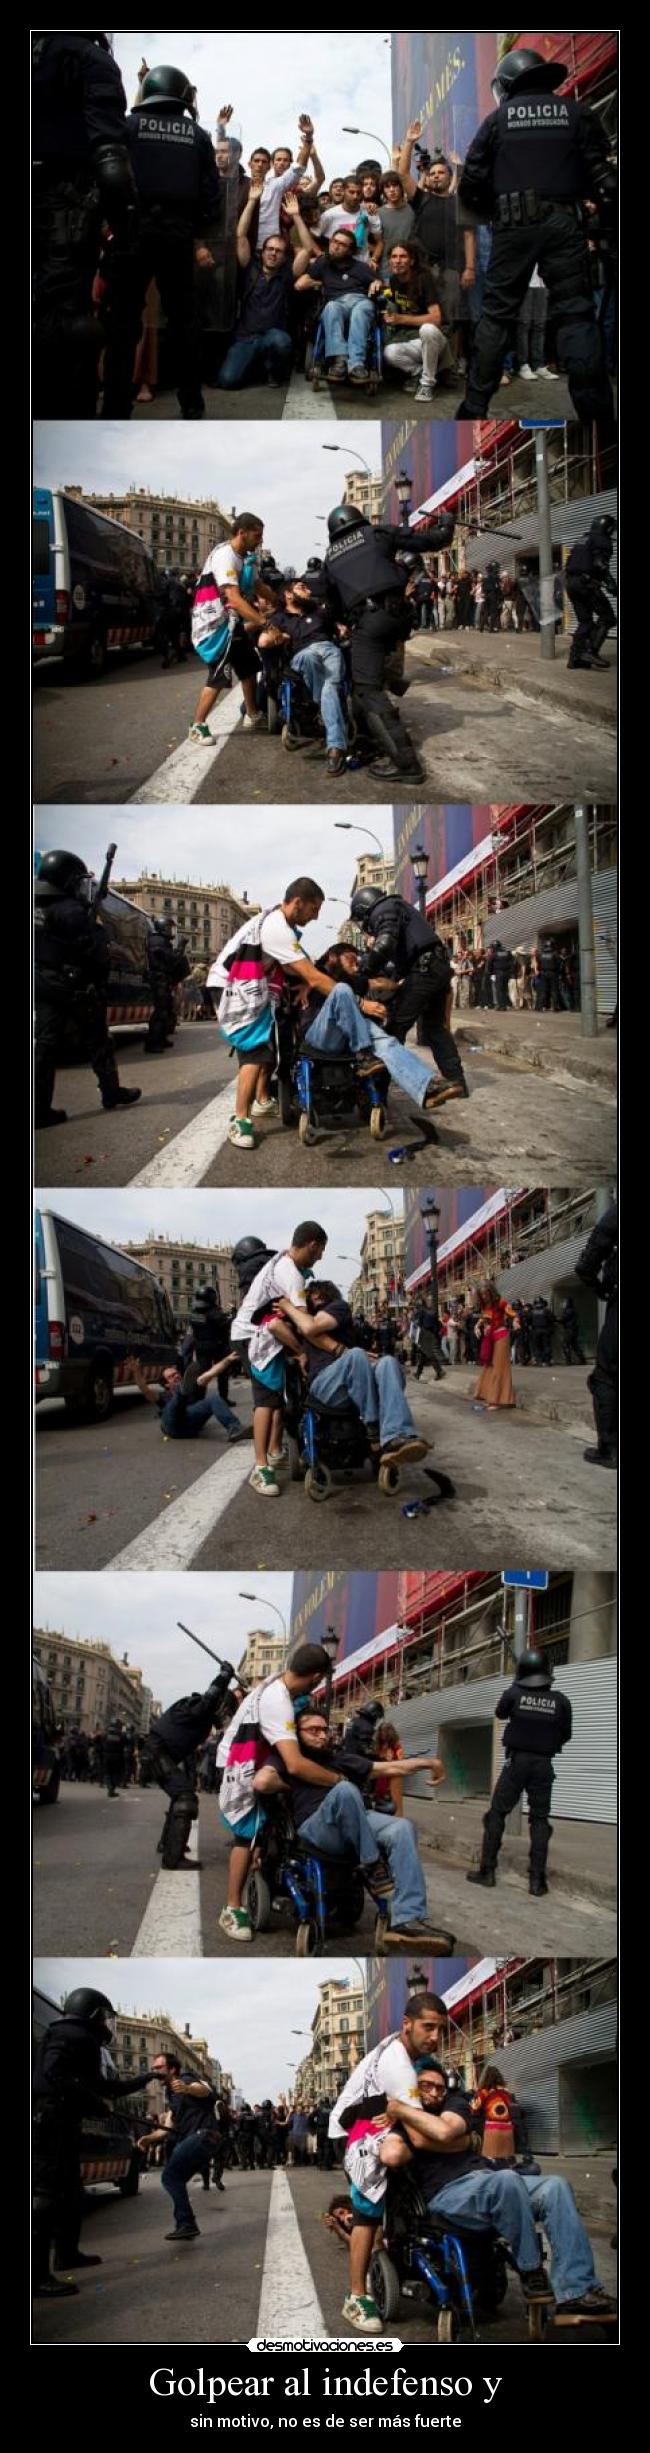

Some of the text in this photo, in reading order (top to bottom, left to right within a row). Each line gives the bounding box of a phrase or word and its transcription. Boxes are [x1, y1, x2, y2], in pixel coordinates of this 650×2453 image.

[508, 104, 569, 119] POLICIA
[138, 118, 194, 136] POLICIA
[327, 530, 364, 555] POLICIA
[520, 1696, 556, 1708] POLICIA
